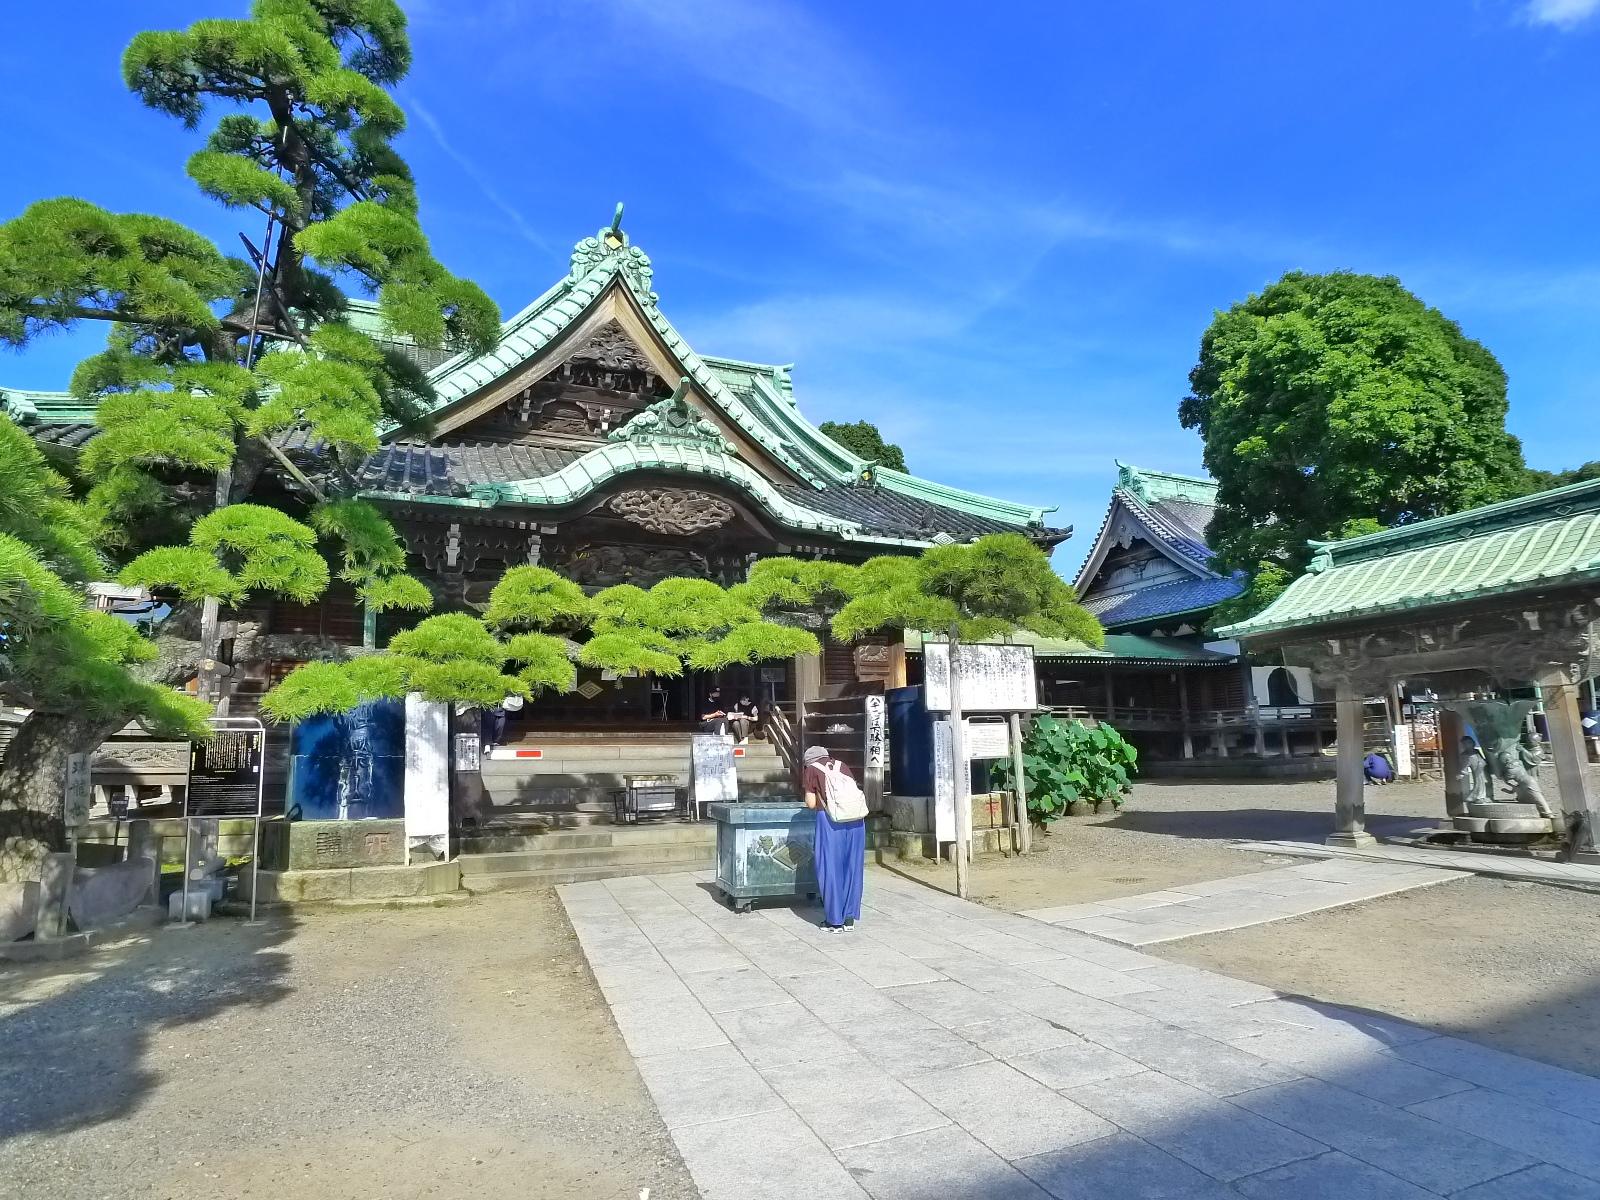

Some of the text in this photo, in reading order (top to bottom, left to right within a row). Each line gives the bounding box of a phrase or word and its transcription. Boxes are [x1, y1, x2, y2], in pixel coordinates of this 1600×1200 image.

[869, 697, 882, 764] ハキは下駄箱へ
